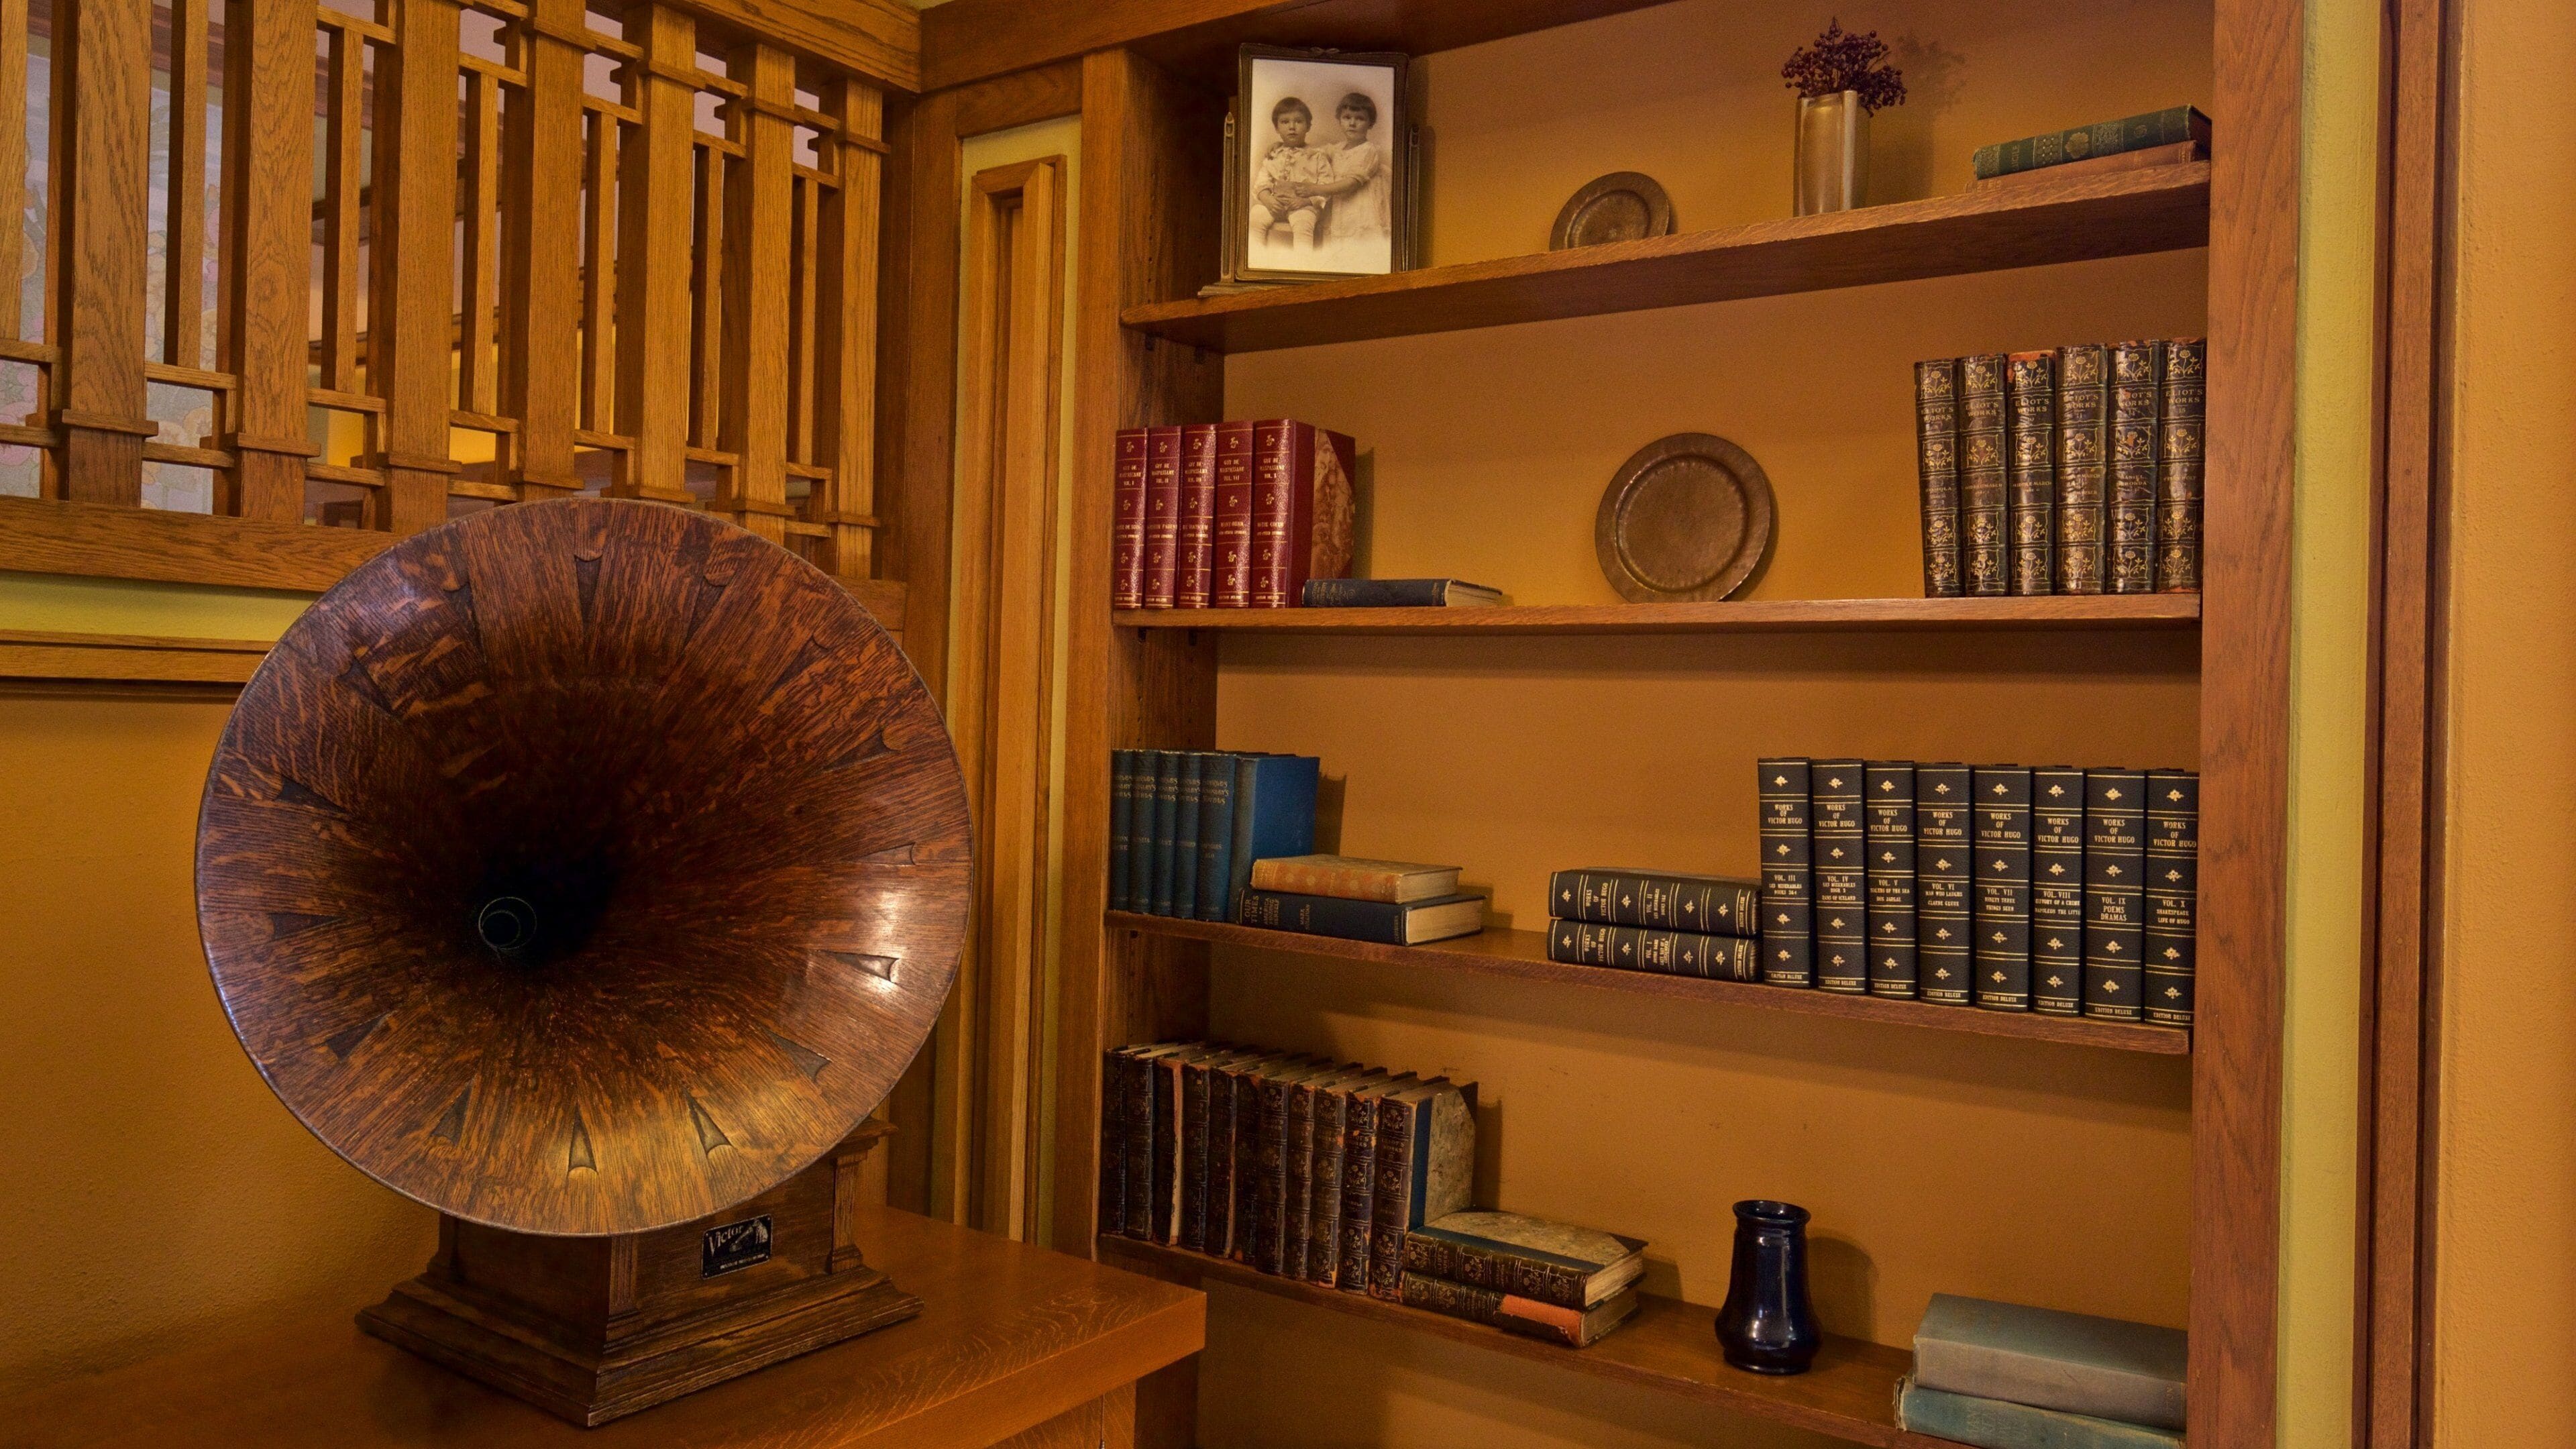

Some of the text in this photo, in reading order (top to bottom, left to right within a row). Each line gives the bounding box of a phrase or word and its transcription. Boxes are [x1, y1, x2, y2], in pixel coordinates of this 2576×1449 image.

[2165, 389, 2202, 397] ELIOT'S
[1250, 896, 1258, 923] TIMES
[1598, 928, 1606, 942] HUGO
[709, 1225, 743, 1256] Victor
